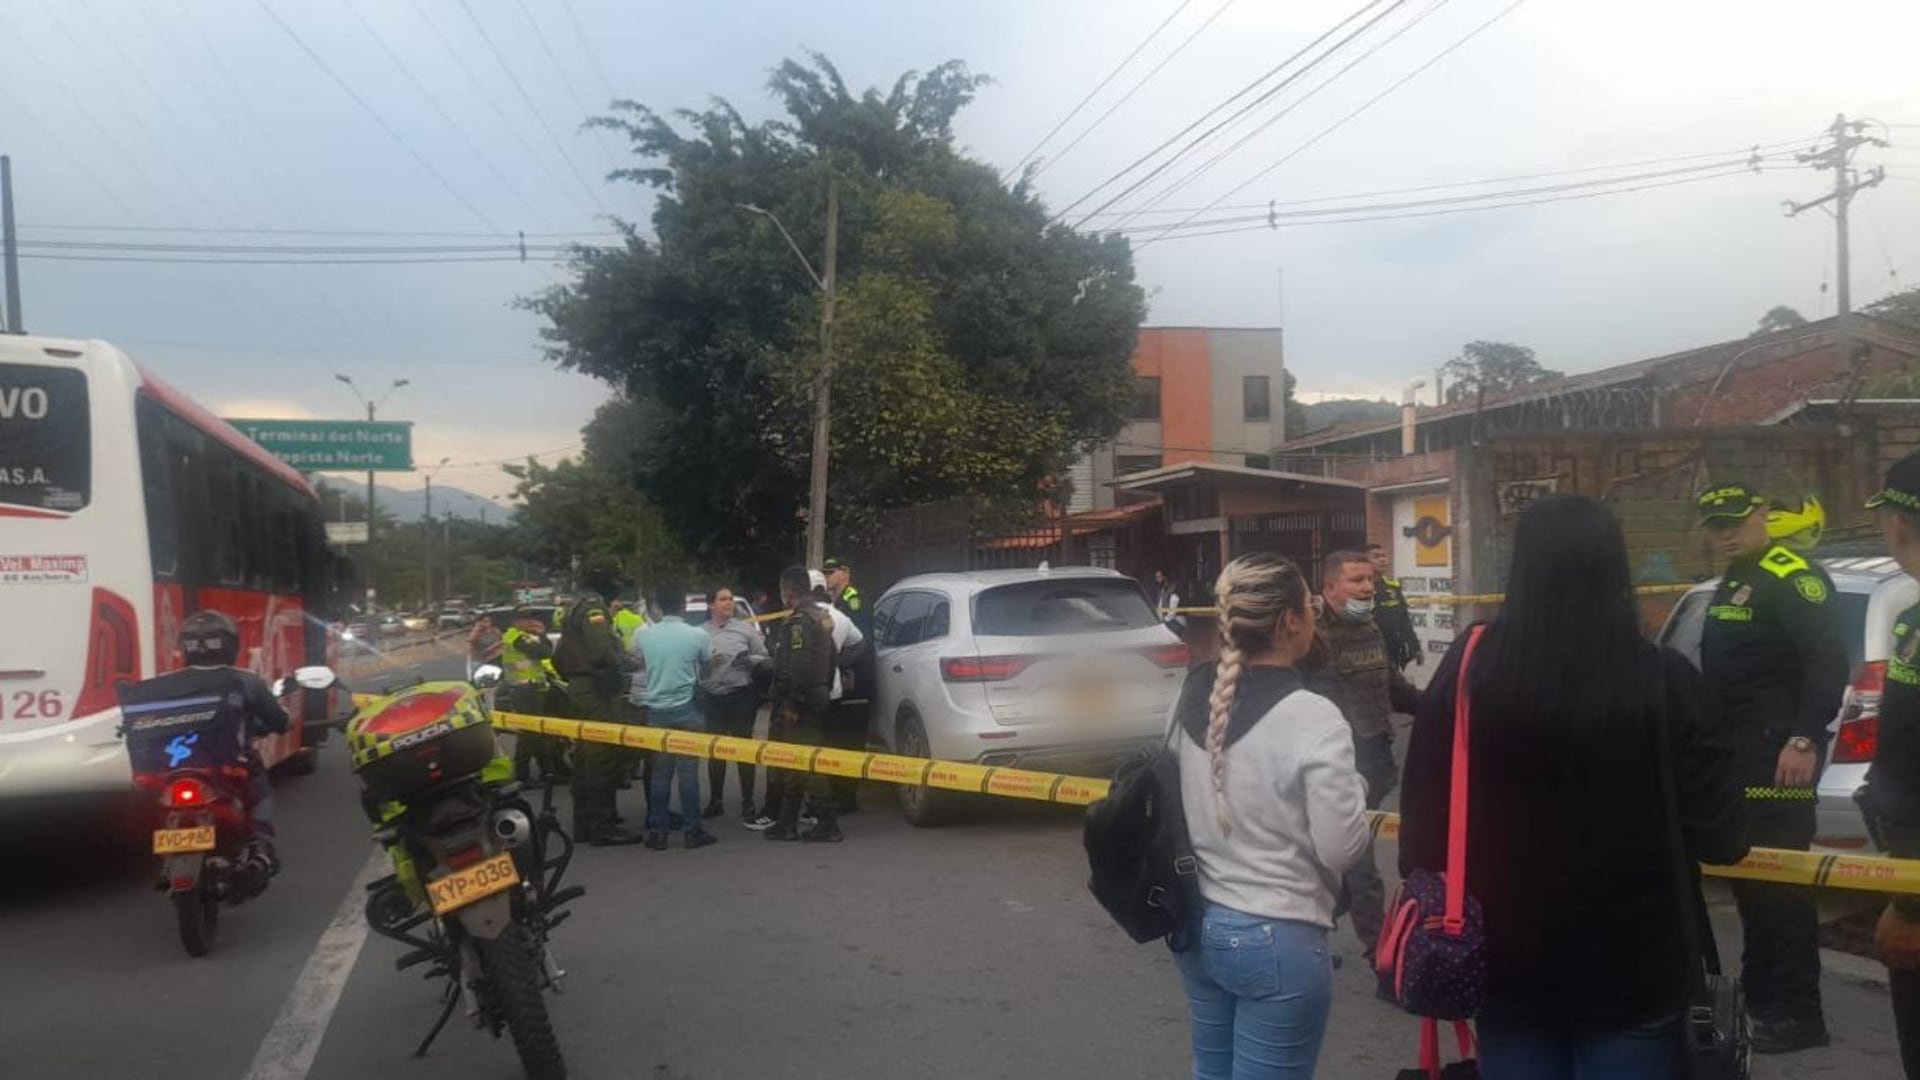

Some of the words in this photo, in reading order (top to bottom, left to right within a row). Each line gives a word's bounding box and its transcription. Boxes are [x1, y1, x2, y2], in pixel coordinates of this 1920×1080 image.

[246, 427, 324, 442] Terminal
[357, 430, 403, 443] Norte
[336, 452, 383, 464] Norte
